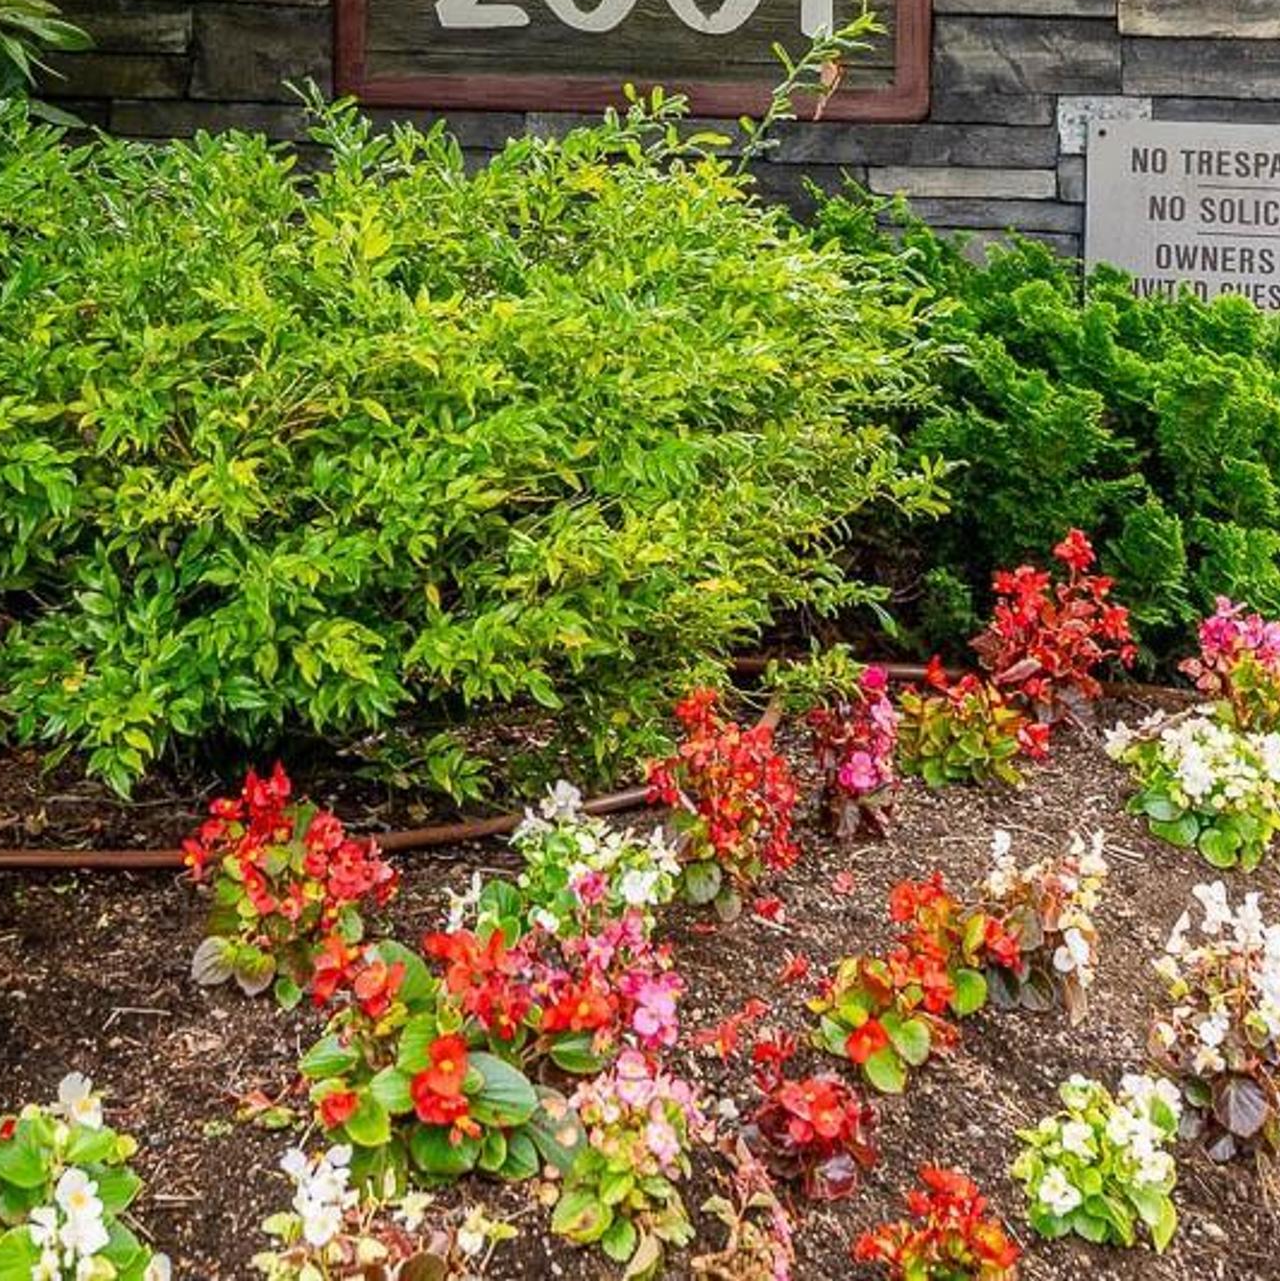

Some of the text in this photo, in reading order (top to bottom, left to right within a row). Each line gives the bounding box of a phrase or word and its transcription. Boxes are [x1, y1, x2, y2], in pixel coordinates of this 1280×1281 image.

[1131, 147, 1167, 174] NO
[1149, 195, 1186, 222] NO
[1155, 243, 1275, 274] OWNERS
